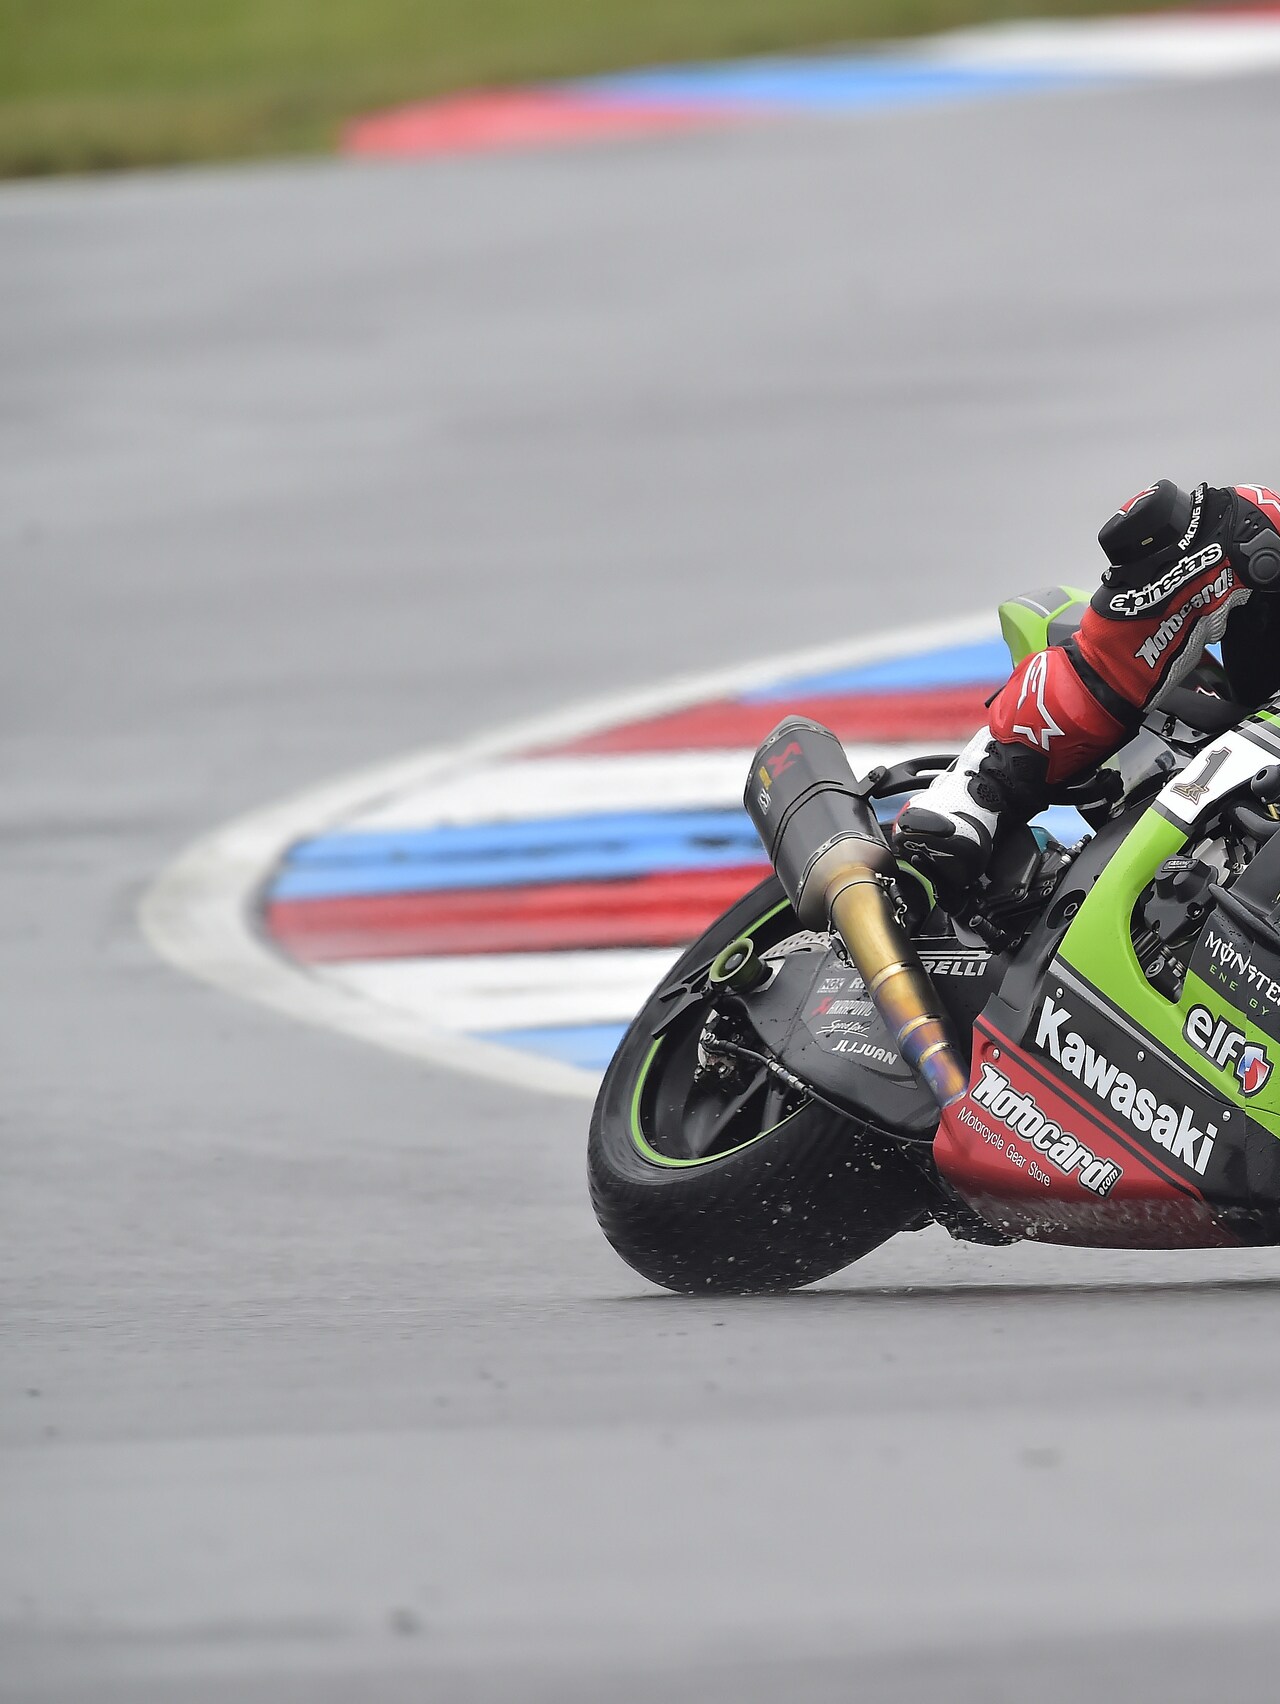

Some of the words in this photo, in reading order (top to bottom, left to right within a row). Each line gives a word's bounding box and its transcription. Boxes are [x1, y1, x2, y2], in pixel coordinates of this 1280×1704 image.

[1178, 506, 1201, 551] RACING
[1170, 746, 1232, 806] 1
[917, 951, 992, 976] RELLI
[1209, 963, 1271, 1017] ENEGY
[1186, 1007, 1247, 1067] elf
[1035, 996, 1218, 1176] Kawasaki
[957, 1106, 1006, 1152] Motorcycle
[1004, 1144, 1028, 1170] Gear
[1026, 1161, 1052, 1188] Store
